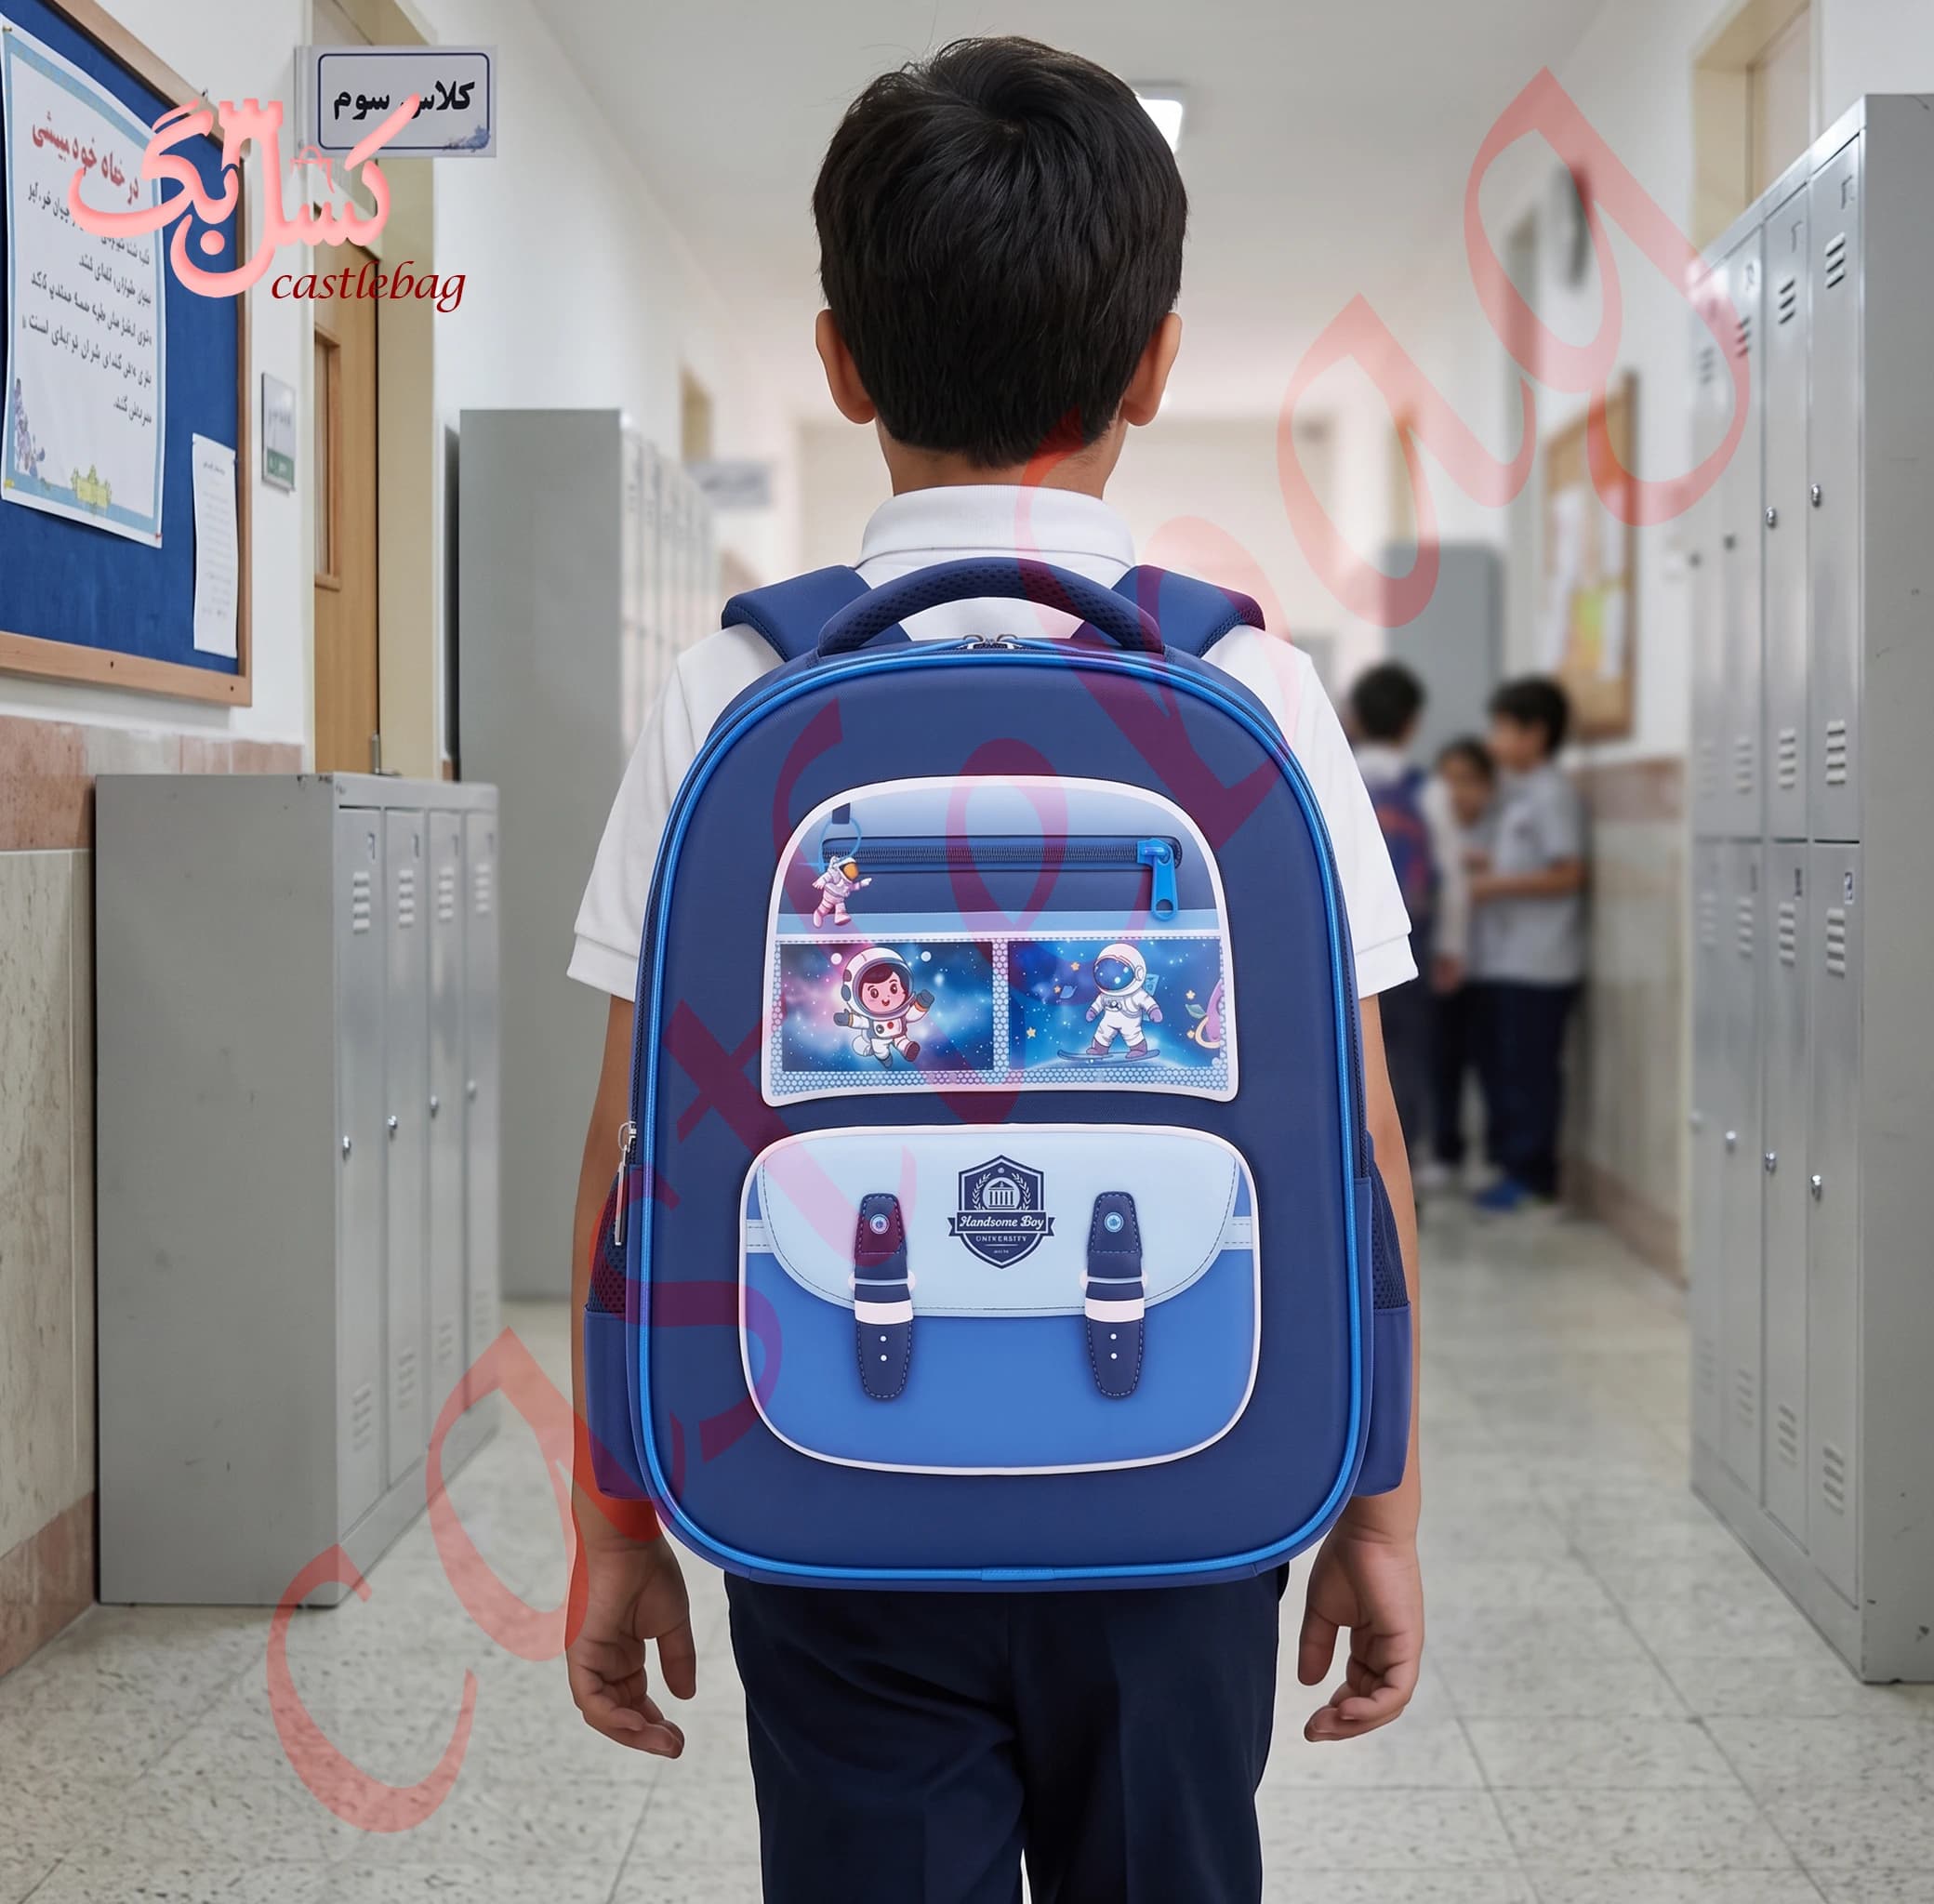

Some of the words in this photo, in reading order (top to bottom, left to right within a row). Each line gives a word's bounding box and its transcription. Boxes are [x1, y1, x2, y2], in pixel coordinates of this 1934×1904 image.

[334, 91, 390, 121] سوم
[959, 1215, 1018, 1228] Handsome
[1020, 1214, 1044, 1231] Boy
